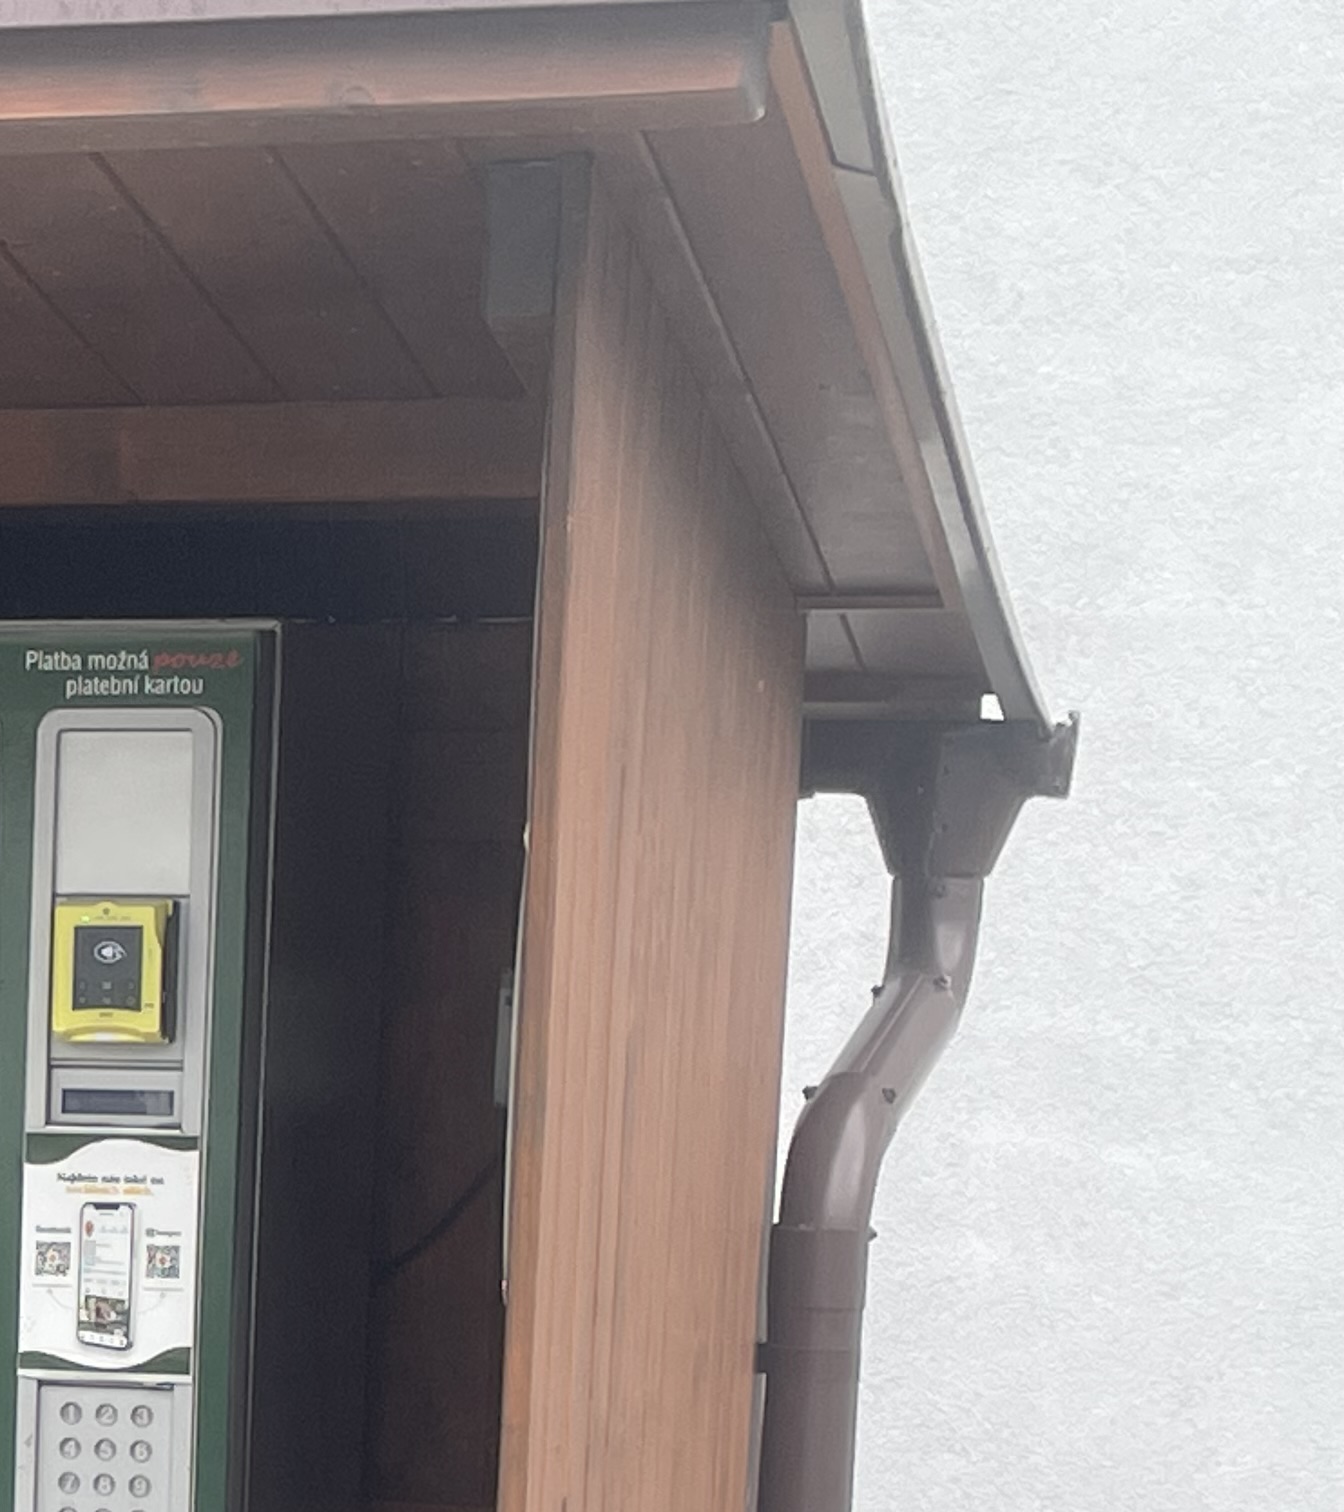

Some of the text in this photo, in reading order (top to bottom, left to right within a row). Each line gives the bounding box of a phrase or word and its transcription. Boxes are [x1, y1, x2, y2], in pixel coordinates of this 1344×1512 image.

[24, 649, 242, 672] Platba možná pouze
[65, 675, 204, 699] platební kartou
